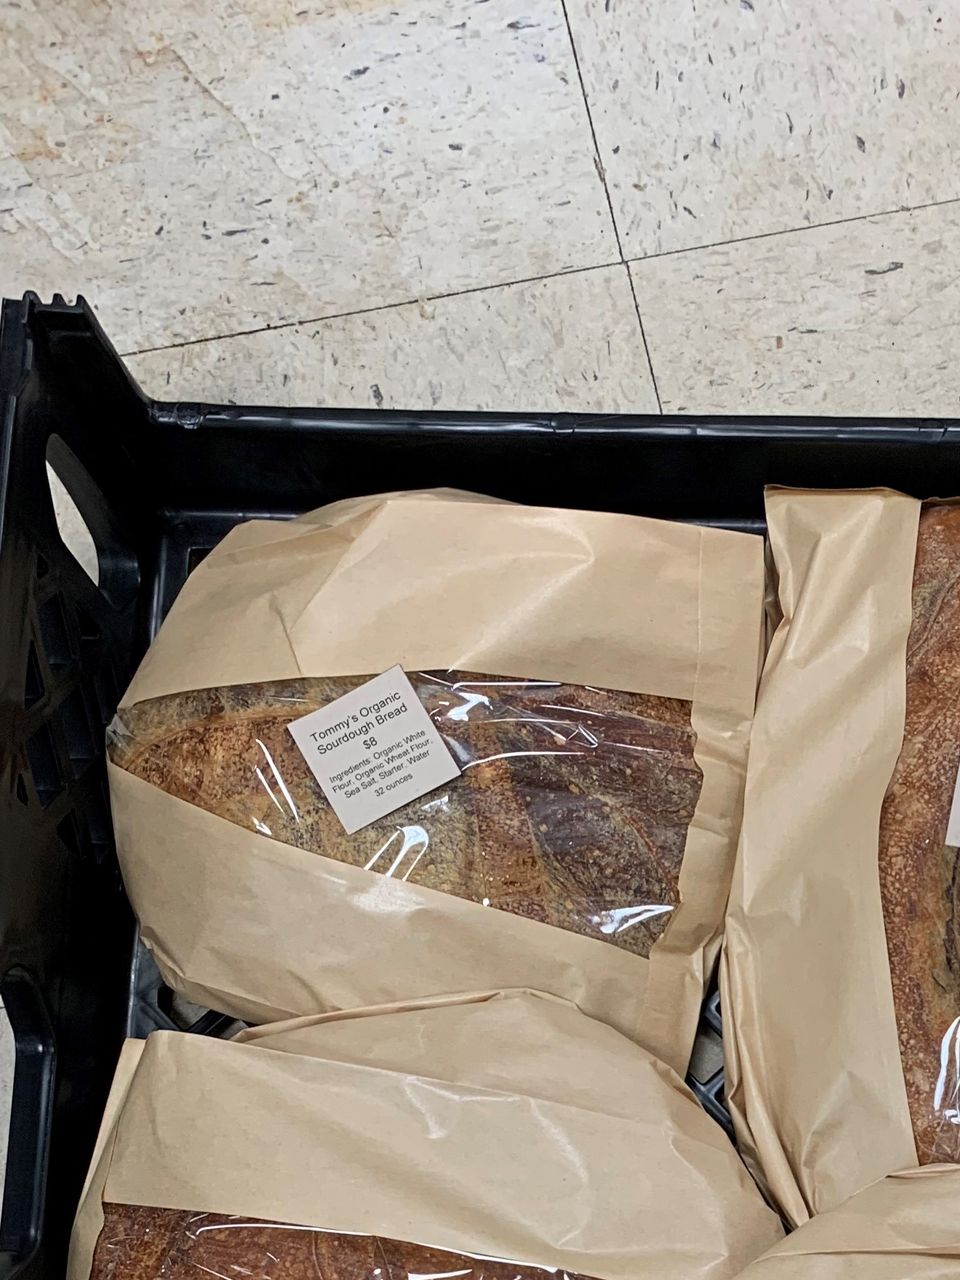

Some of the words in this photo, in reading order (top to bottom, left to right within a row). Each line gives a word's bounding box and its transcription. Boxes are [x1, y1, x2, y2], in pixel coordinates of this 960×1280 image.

[310, 715, 358, 742] Tommy's
[360, 692, 401, 717] Organic
[317, 721, 375, 755] Sourdough
[376, 703, 407, 725] Bread
[362, 737, 377, 750] $8
[373, 742, 403, 760] Organic
[403, 730, 426, 744] White
[344, 788, 360, 799] Sea
[407, 751, 430, 765] Water
[355, 762, 384, 782] Organic
[385, 750, 410, 765] Wheat
[375, 787, 385, 797] 32
[386, 774, 413, 791] ounces
